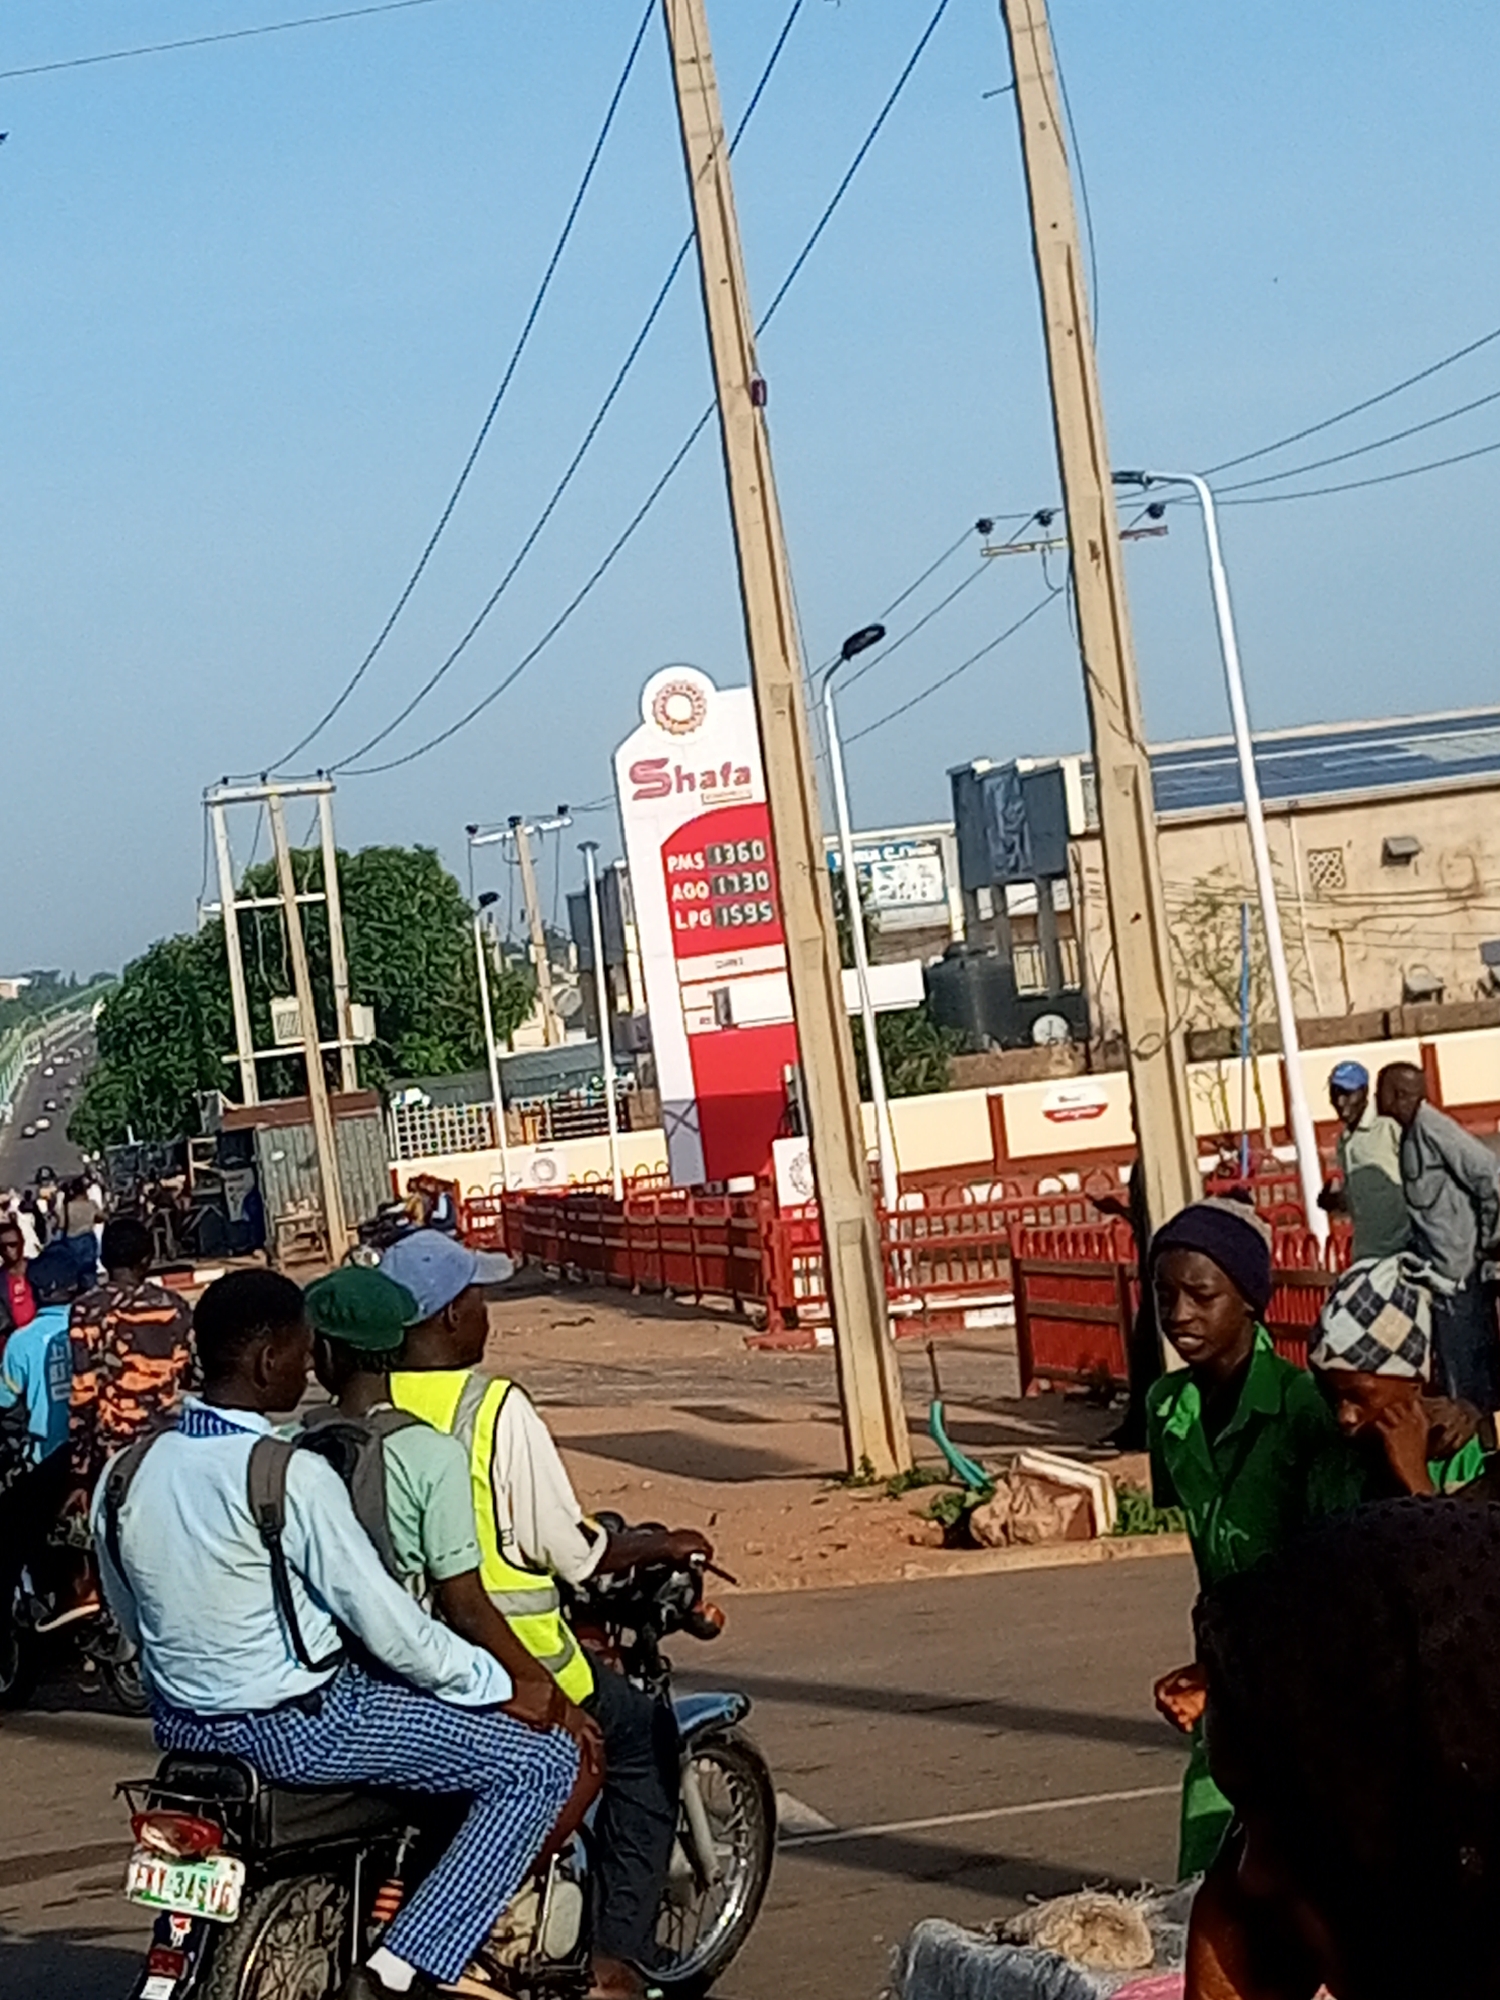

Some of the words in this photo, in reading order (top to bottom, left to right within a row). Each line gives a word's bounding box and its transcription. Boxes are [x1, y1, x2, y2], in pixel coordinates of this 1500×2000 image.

[629, 757, 751, 801] Shafa
[667, 852, 705, 873] PMS
[714, 840, 765, 865] 1360
[718, 871, 769, 895] 1730
[675, 908, 712, 930] LPG
[721, 901, 773, 926] 1595
